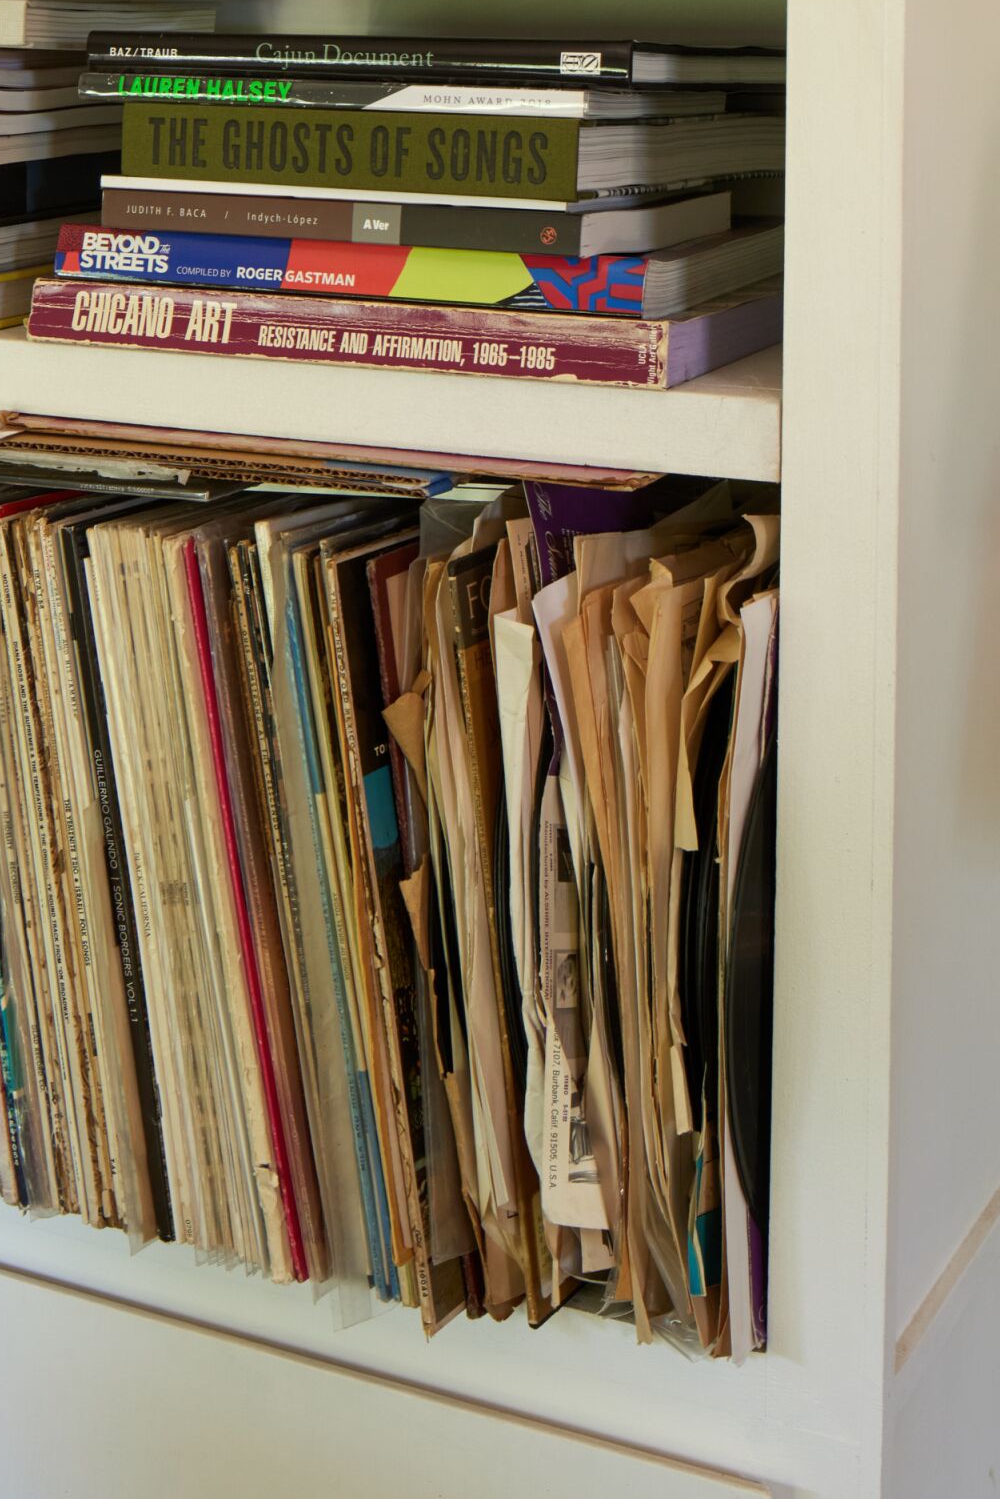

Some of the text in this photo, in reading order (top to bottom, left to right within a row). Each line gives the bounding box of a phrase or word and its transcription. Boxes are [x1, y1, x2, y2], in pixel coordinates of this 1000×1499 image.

[109, 47, 178, 59] BAZ/TRAUB
[256, 42, 434, 70] Cajun Document
[118, 75, 293, 103] LAUREN HALSEY
[423, 94, 513, 106] MOHN AWARD
[148, 117, 548, 185] THE GHOSTS OF SONGS
[126, 205, 318, 225] JUDITH BACA Indych-López
[82, 232, 160, 255] BEYOND
[80, 252, 169, 274] STREETS
[236, 266, 355, 287] ROGER GASTMAN
[72, 290, 237, 344] CHICANO ART
[257, 324, 336, 353] RESISTANCE
[339, 332, 368, 355] AND
[372, 334, 465, 366] AFFIRMATION,
[94, 750, 133, 978] GUILLERMO GALINDO SONIC BORDERS
[549, 1070, 560, 1106] Burbank,
